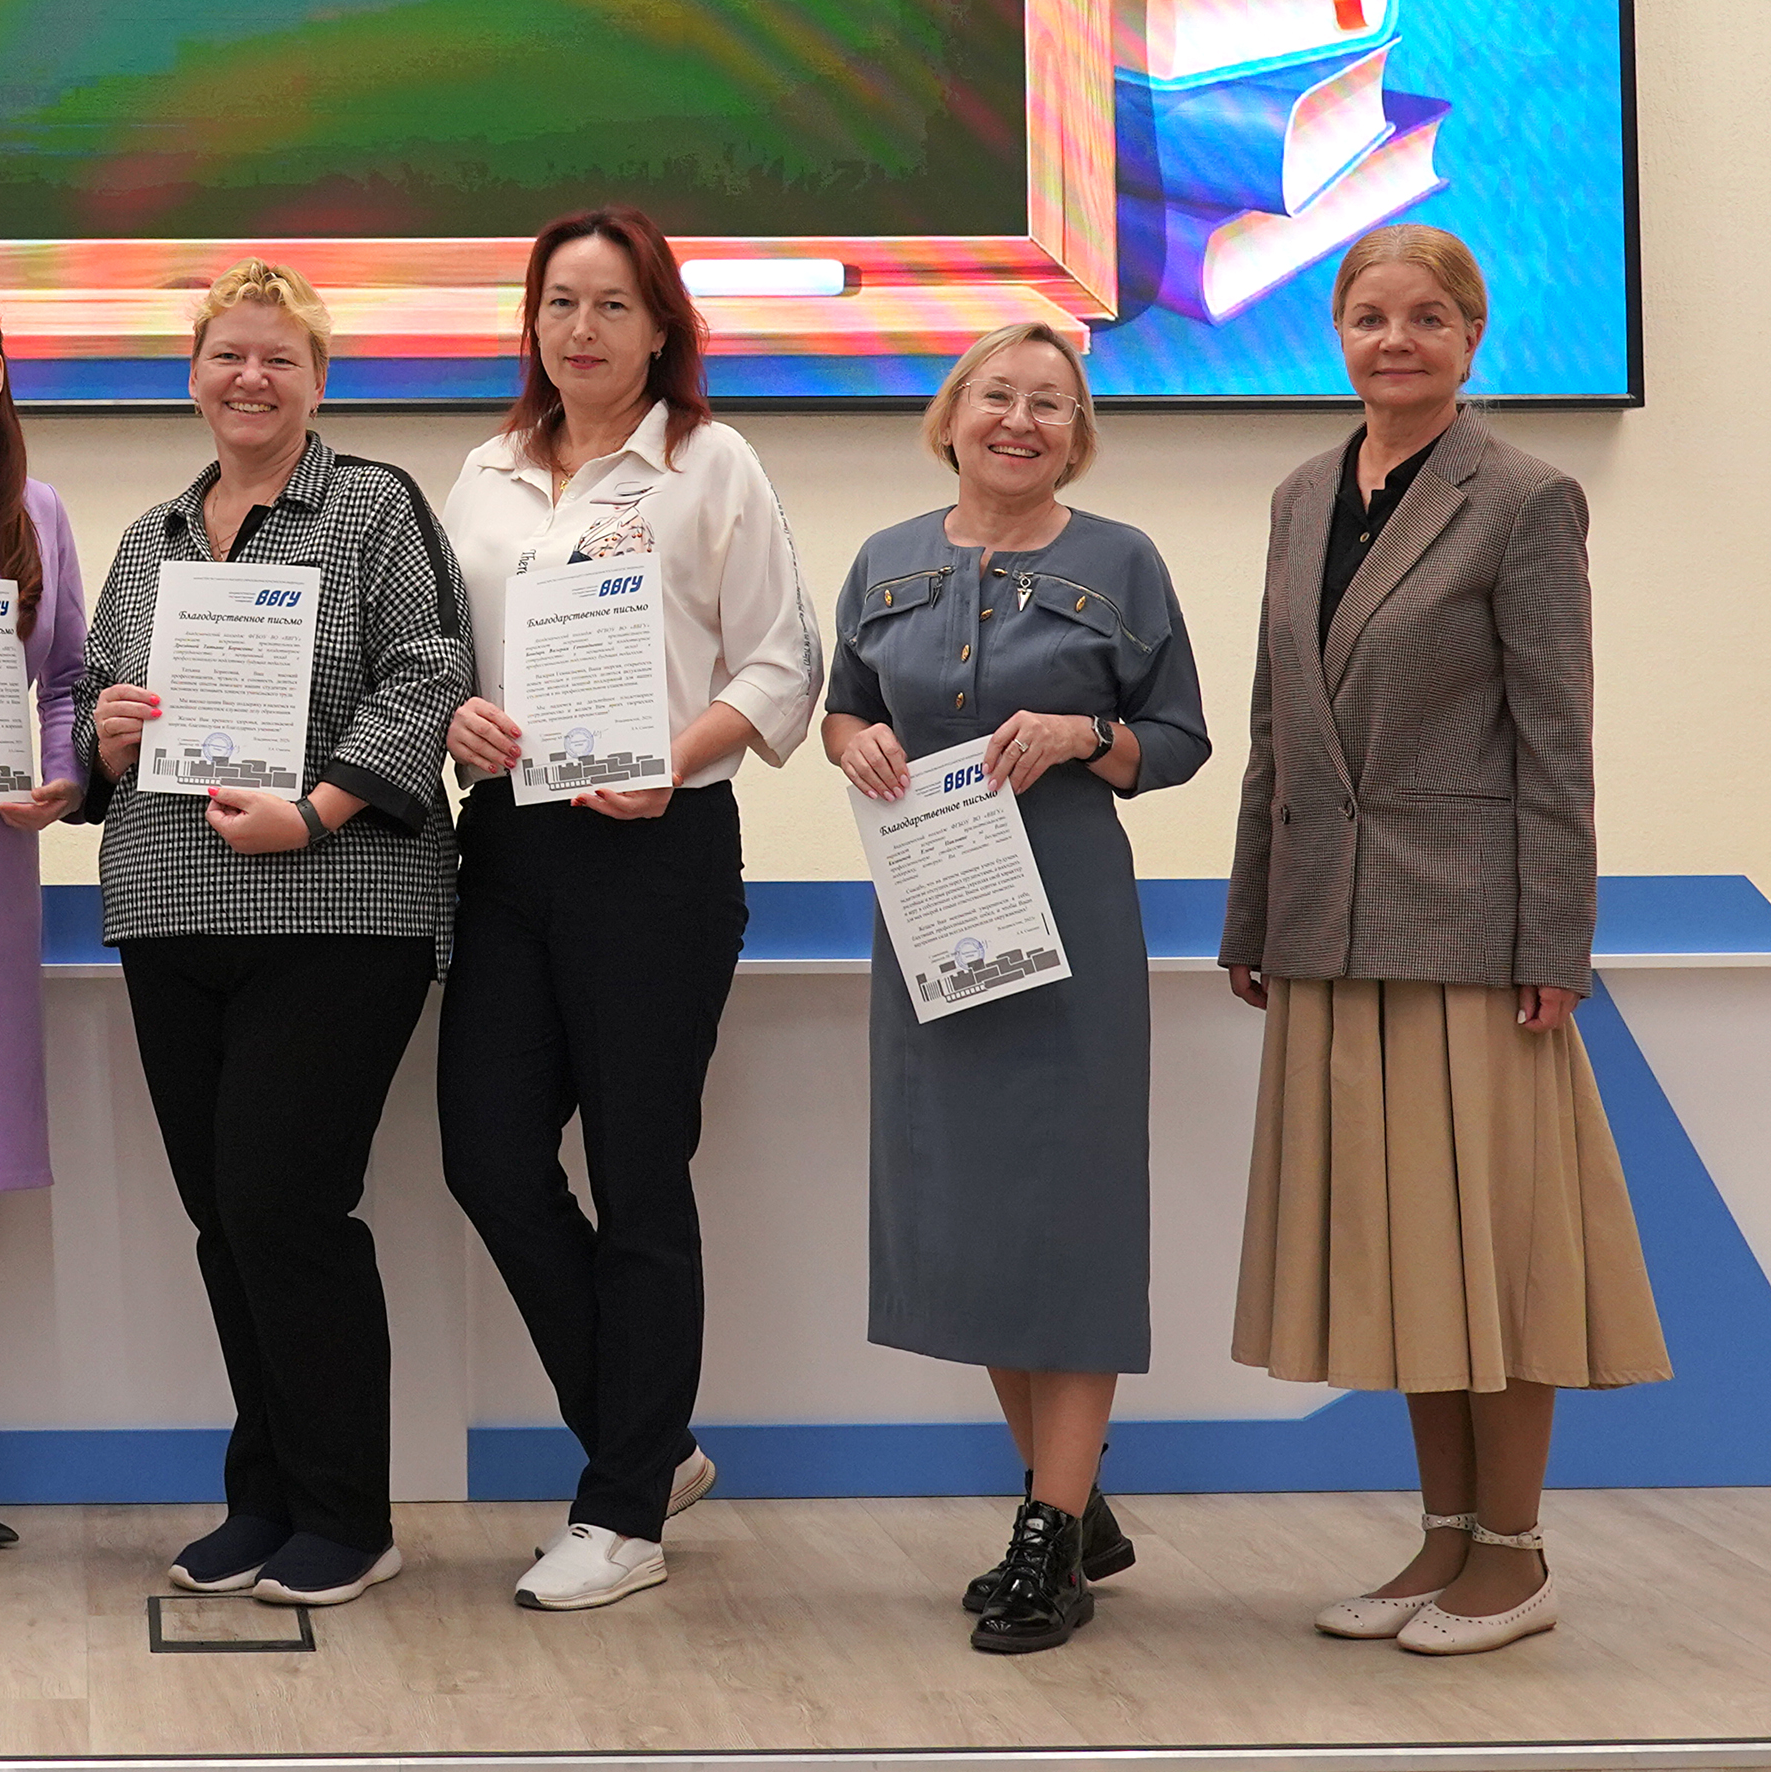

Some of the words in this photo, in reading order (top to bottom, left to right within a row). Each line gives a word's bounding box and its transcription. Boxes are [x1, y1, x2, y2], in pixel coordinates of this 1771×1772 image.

[598, 575, 644, 597] ВВГУ
[254, 589, 302, 607] ВВГУ
[178, 610, 265, 625] Благодарственное
[267, 616, 303, 626] письмо
[526, 608, 611, 628] Благодарственное
[613, 603, 649, 614] письмо
[944, 762, 985, 793] ВВГУ
[879, 801, 960, 836] Благодарственное
[963, 790, 998, 807] письмо
